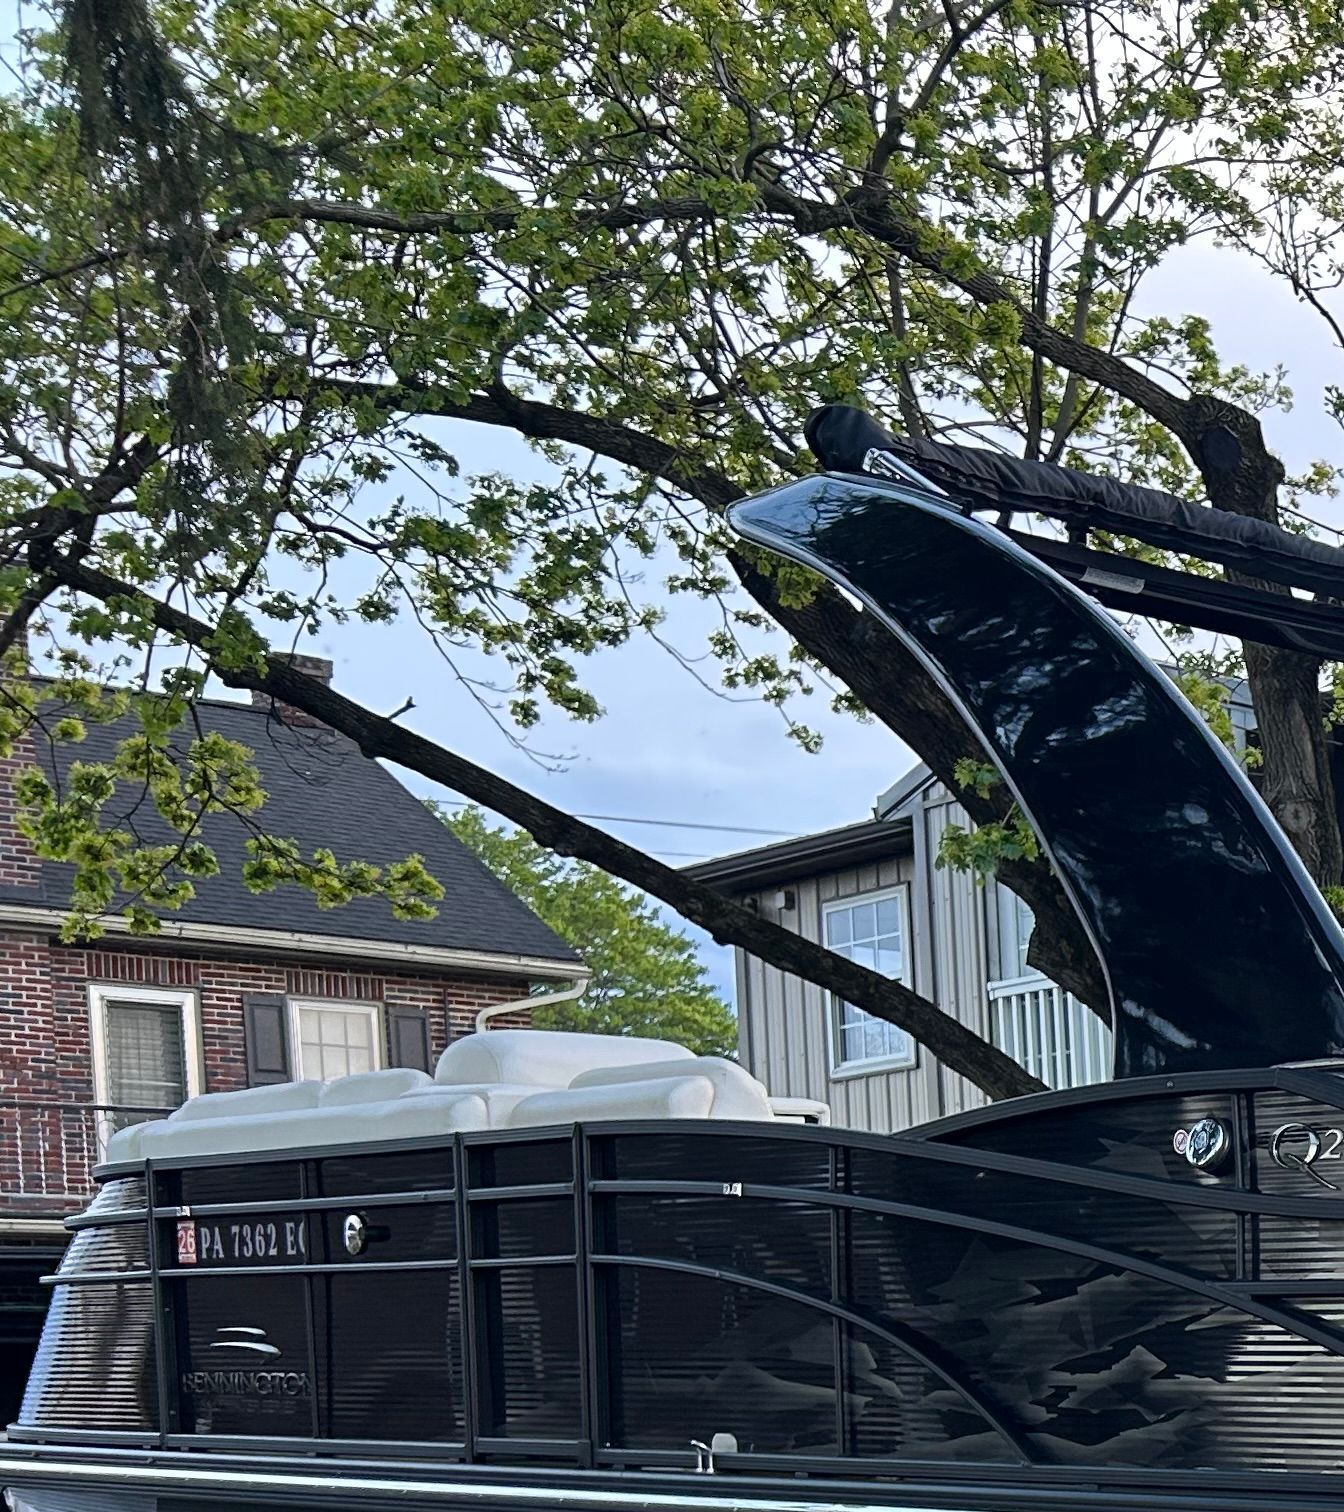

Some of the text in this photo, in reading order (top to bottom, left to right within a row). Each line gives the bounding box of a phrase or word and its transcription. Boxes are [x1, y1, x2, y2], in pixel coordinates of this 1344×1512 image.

[178, 1230, 195, 1253] 26
[201, 1227, 225, 1259] PA
[231, 1222, 278, 1257] 7362
